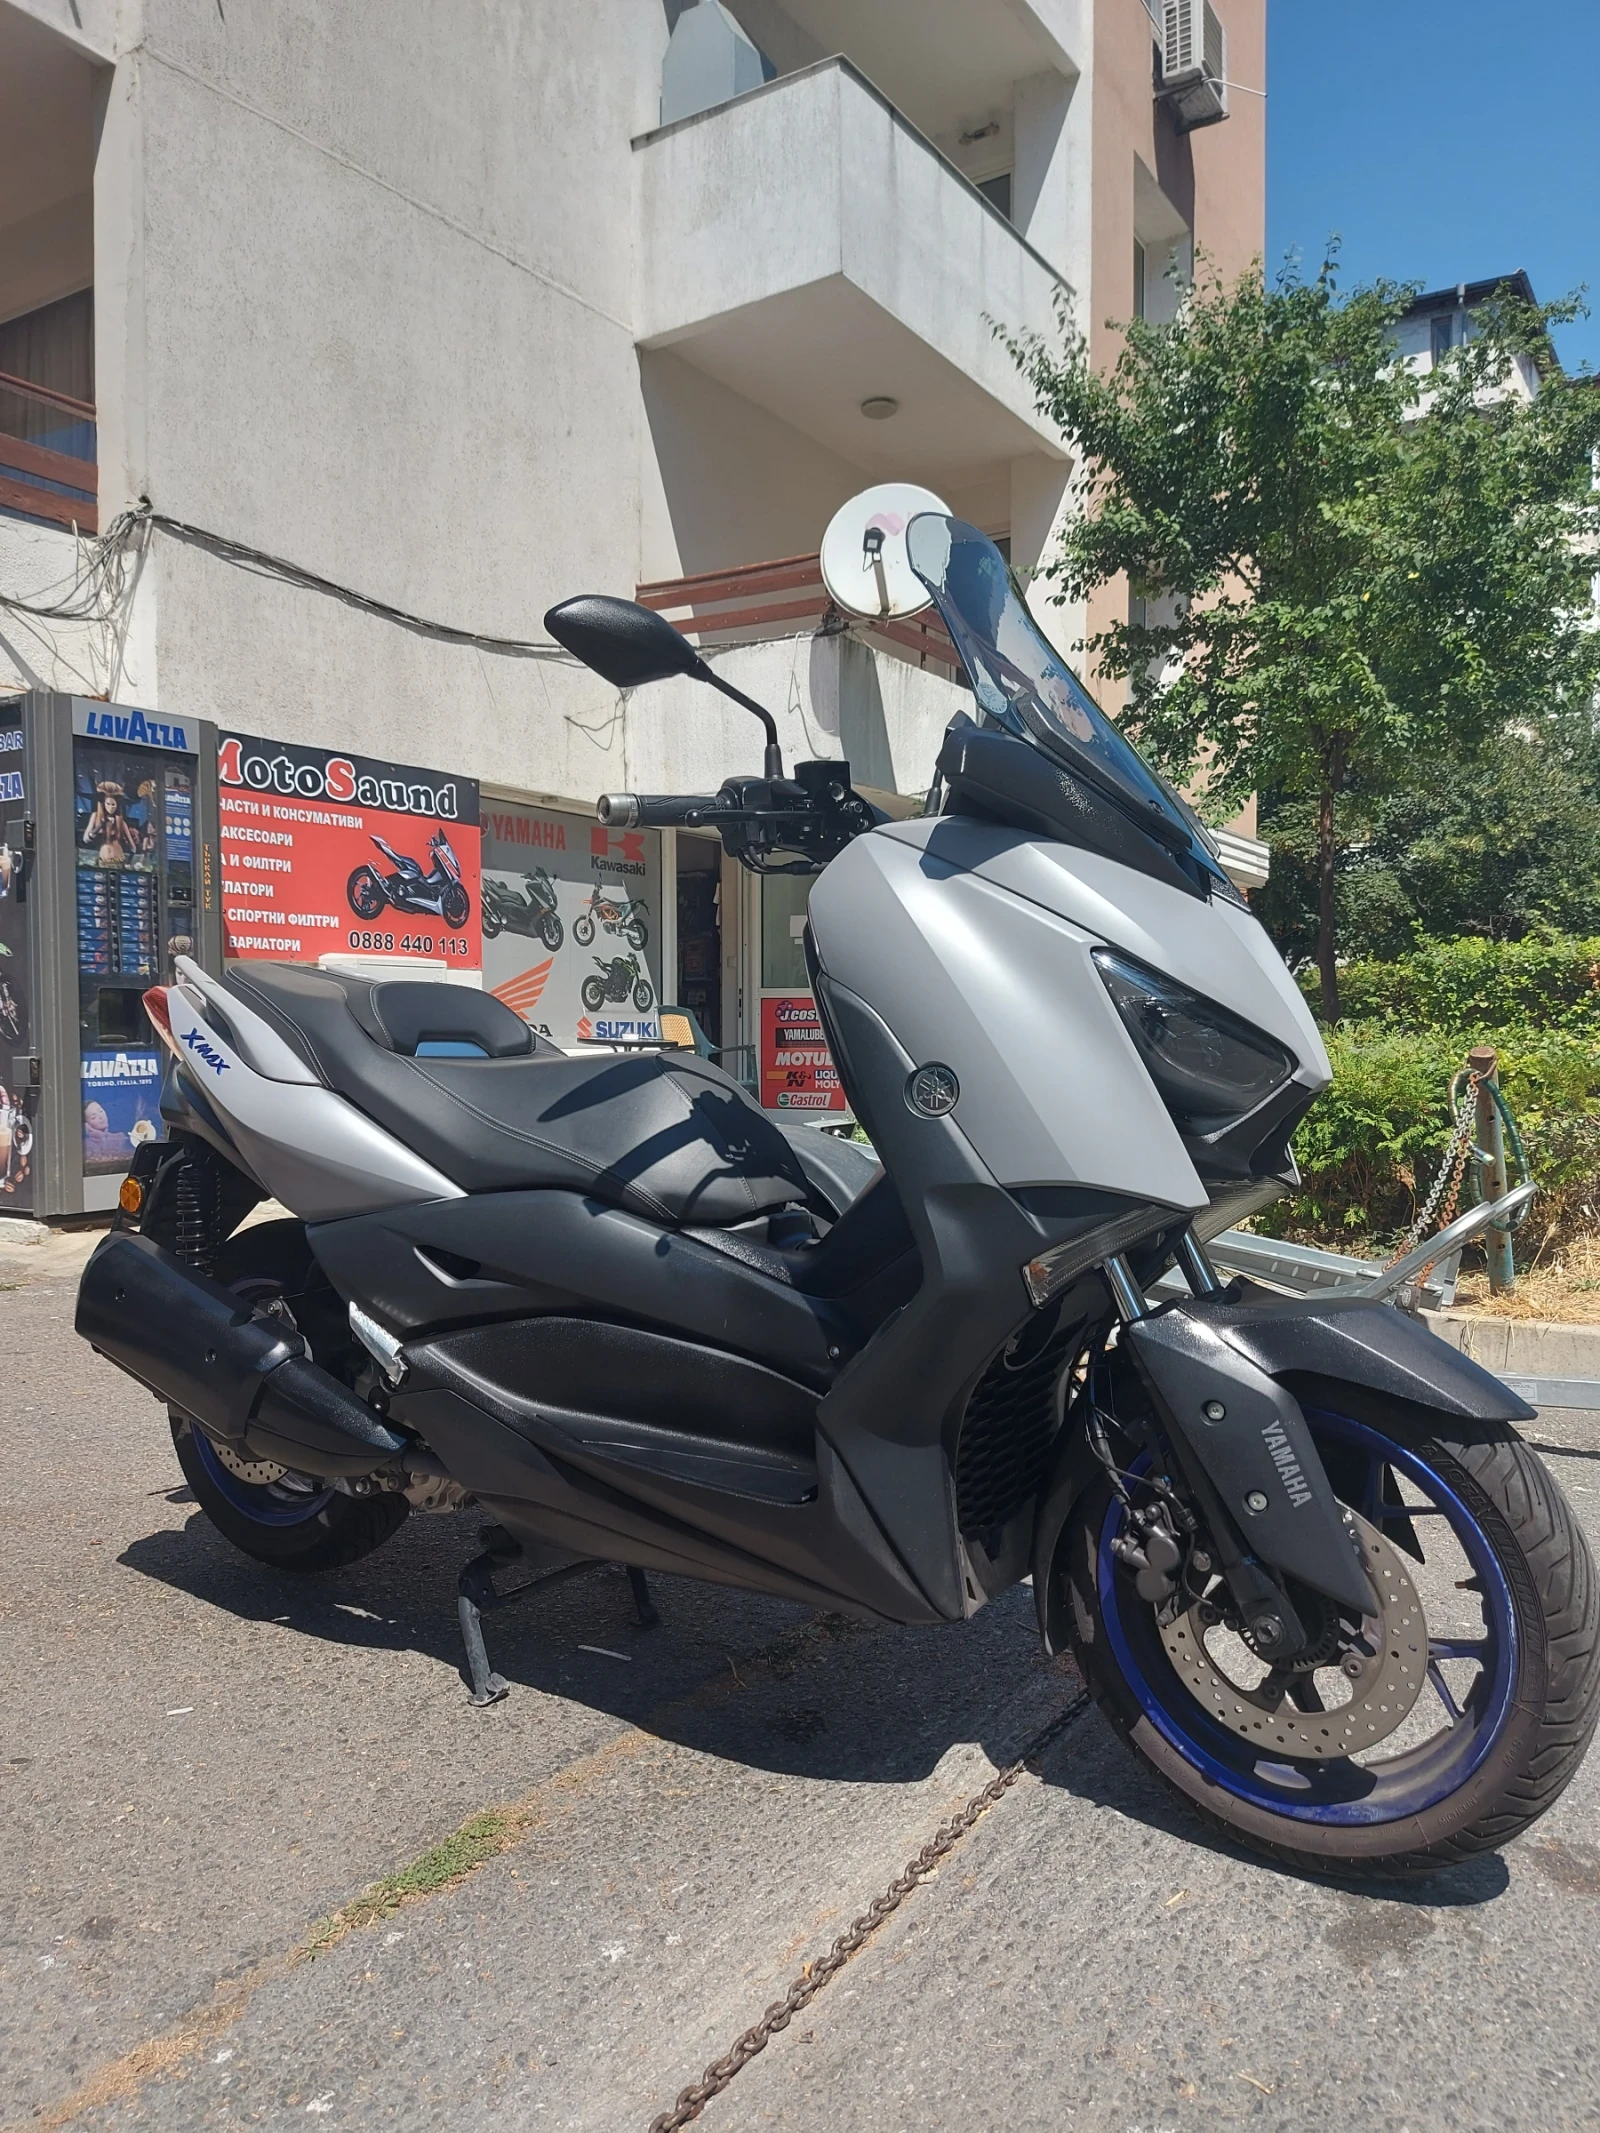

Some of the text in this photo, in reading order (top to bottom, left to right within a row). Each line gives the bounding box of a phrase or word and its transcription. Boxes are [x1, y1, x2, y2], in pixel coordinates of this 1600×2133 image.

[87, 711, 187, 750] LAVAZZA
[0, 772, 25, 802] ZA
[218, 738, 458, 818] MotoSaund
[219, 797, 363, 829] ЧАСТИ И КОНСУМАТИВИ
[220, 826, 293, 847] АКСЕСОАРИ
[492, 813, 566, 850] YAMAHA
[230, 853, 240, 867] И
[242, 855, 291, 873] ФИЛТРИ
[591, 856, 646, 876] Kawasaki
[222, 880, 274, 897] ЛАТОРИ
[227, 907, 339, 929] СПОРТНИ ФИЛТРИ
[229, 935, 301, 953] ВАРИАТОРИ
[349, 931, 468, 955] 0888 440 113
[595, 1020, 657, 1038] SUZUKI
[81, 1053, 159, 1079] LAVAZZA
[775, 1051, 833, 1066] MOTUL
[815, 1070, 839, 1080] LIQU
[815, 1080, 840, 1089] MOLY
[790, 1094, 827, 1106] Castrol
[1260, 1419, 1313, 1508] YAMAHA
